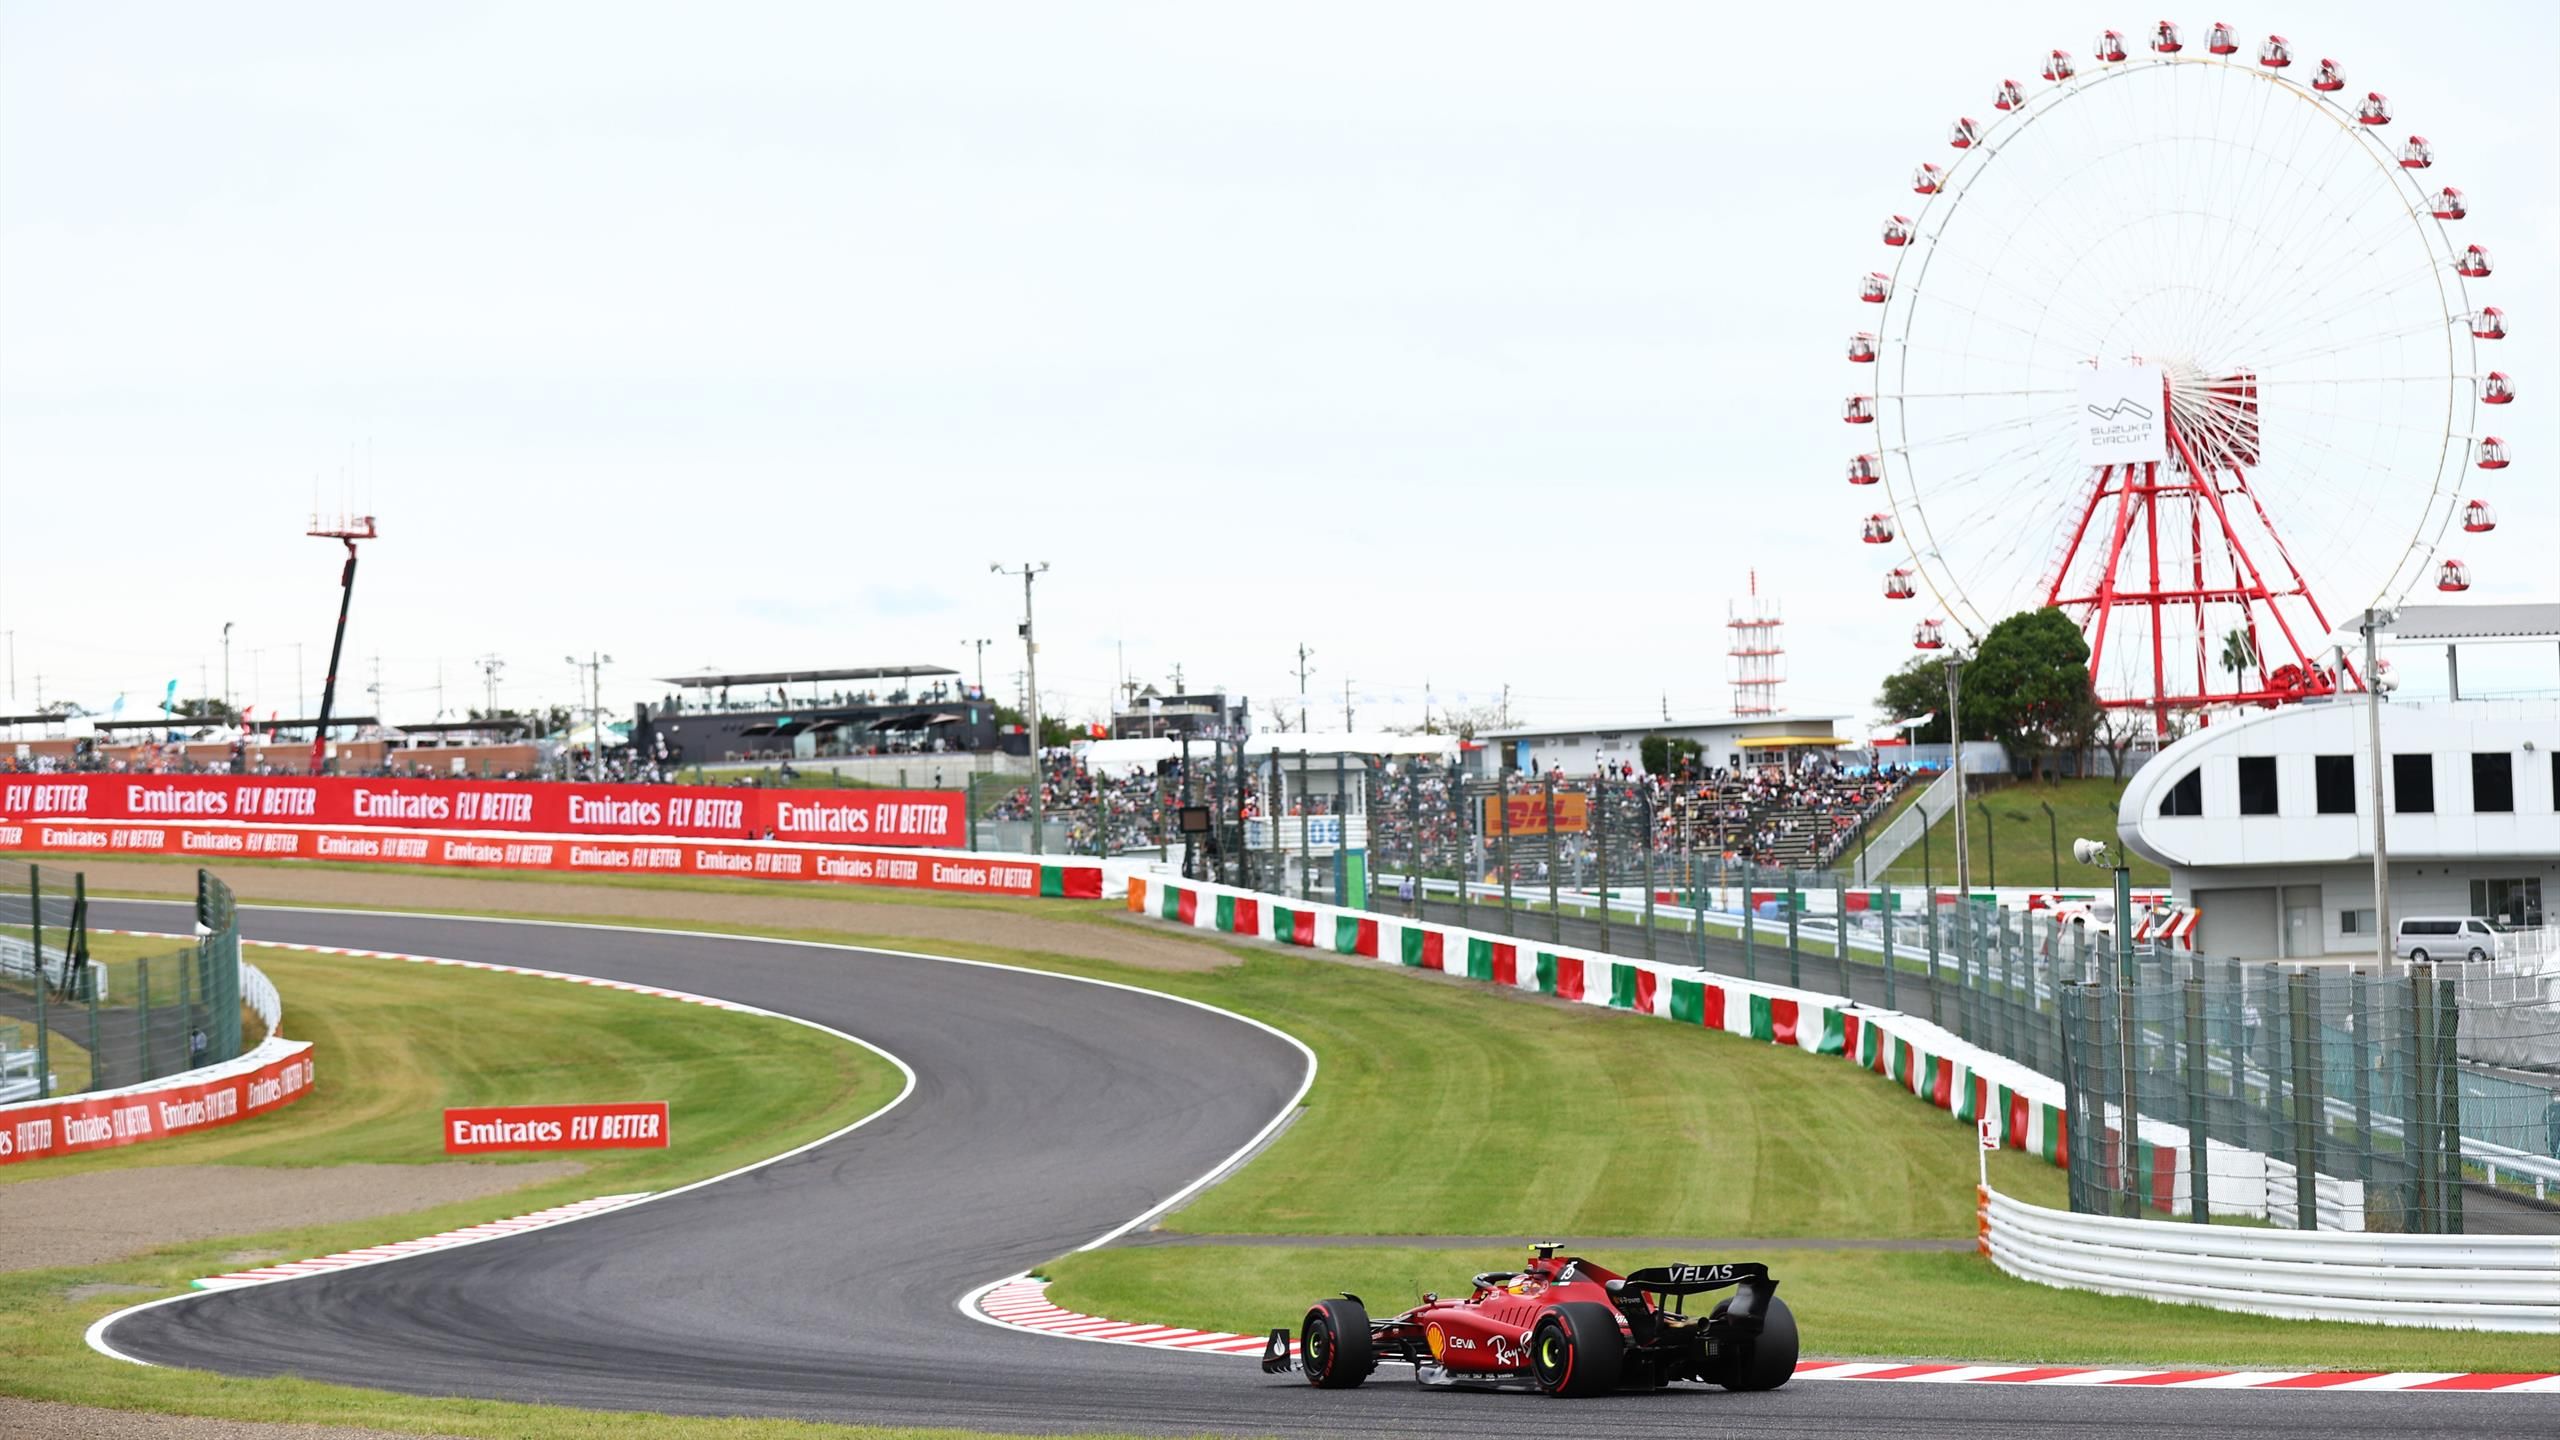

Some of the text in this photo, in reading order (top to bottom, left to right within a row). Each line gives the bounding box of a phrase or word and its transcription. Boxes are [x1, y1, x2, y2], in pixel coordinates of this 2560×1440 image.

[2090, 422, 2152, 436] SUZUKA
[2091, 432, 2151, 446] CIRCUIT
[5, 785, 89, 813] FLY BETTER
[127, 784, 317, 816] Emirates FLY BETTER
[353, 788, 533, 822] Emirates FLY BETTER
[568, 794, 744, 830] Emirates FLY BETTER
[777, 801, 948, 836] Emirates FLY BETTER
[1504, 799, 1569, 829] DHL
[41, 828, 165, 849] Emirates FLY BETTER
[182, 830, 299, 852] Emirates FLY BETTER
[317, 835, 429, 859] Emirates FLY BETTER
[444, 841, 553, 865] Emirates FLY BETTER
[570, 846, 682, 869] Emirates FLY BETTER
[696, 850, 802, 875] Emirates FLY BETTER
[816, 855, 918, 881] Emirates FLY BETTER
[932, 862, 1032, 890] Emirates FLY BETTER
[159, 1098, 205, 1130] Emirates
[453, 1113, 660, 1145] Emirates FLY BETTER
[1668, 1264, 1733, 1284] VELAS
